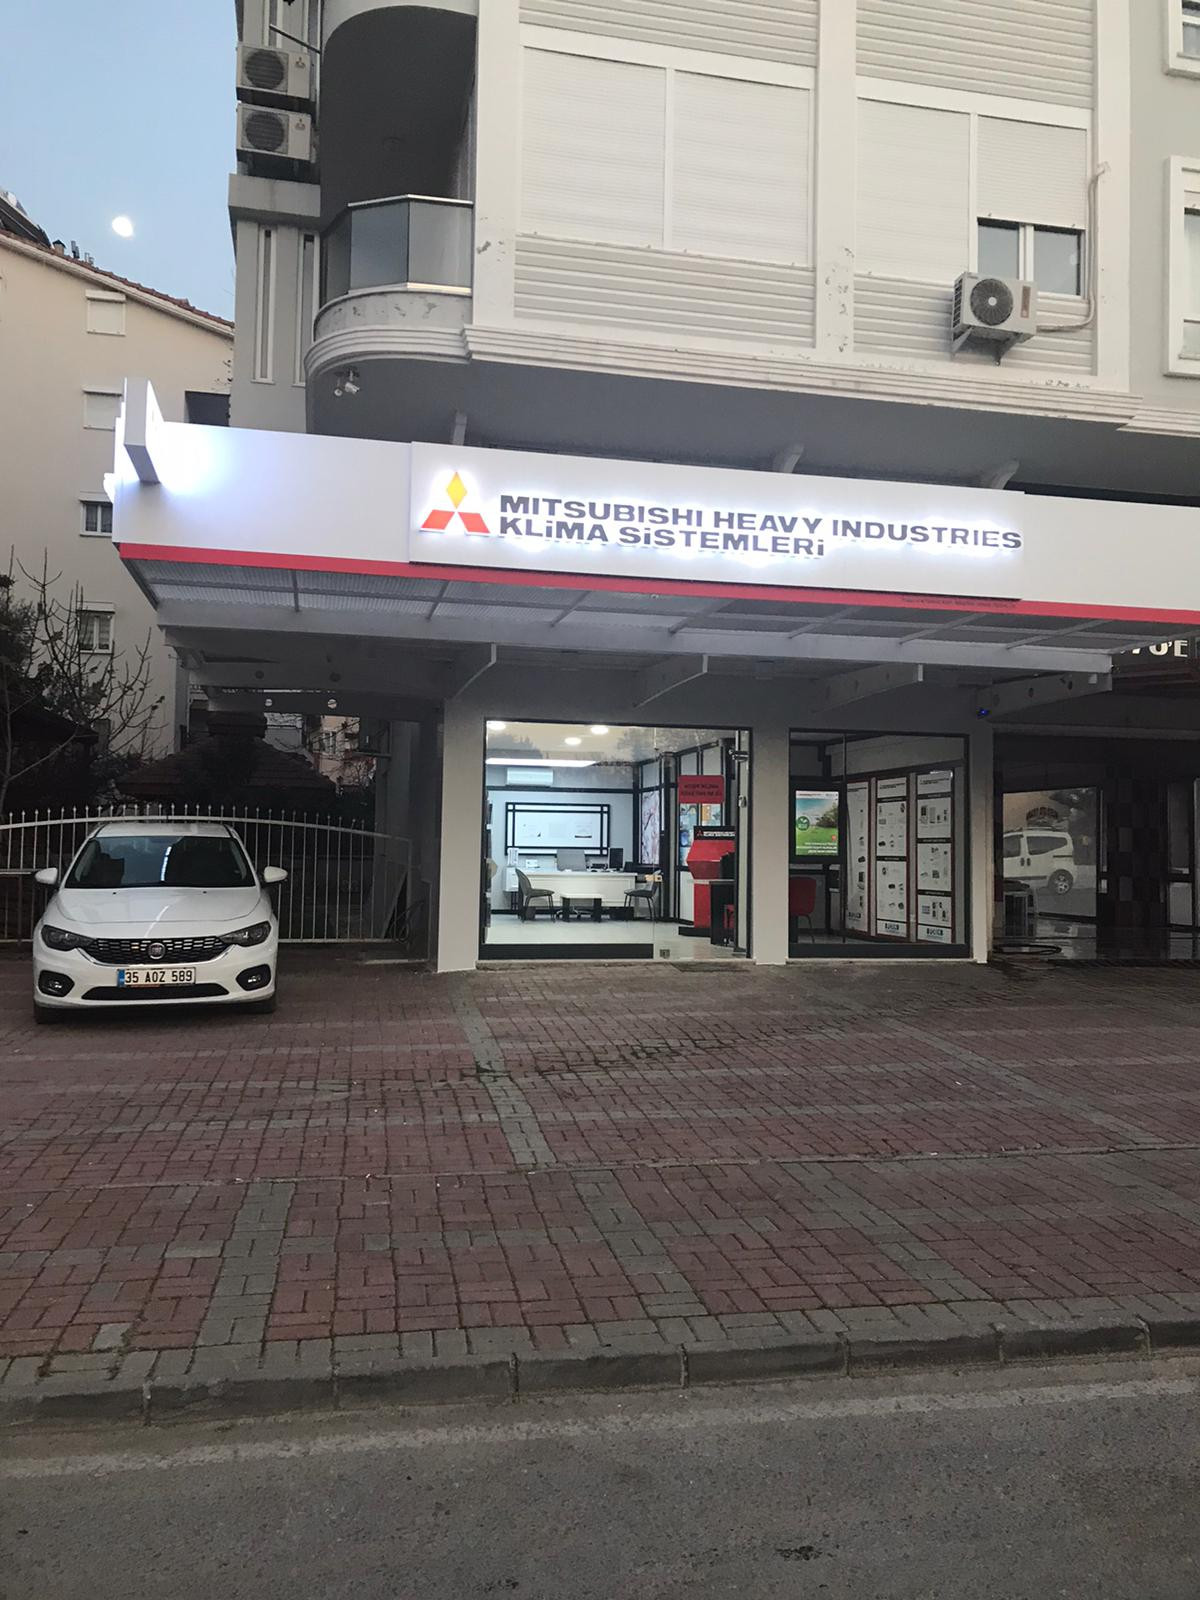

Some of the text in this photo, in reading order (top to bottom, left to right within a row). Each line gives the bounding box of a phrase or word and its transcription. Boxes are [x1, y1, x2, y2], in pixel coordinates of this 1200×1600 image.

[500, 495, 1022, 549] MITSUBISHI HEAVY INDUSTRIES
[125, 970, 193, 983] 35 AOZ 589
